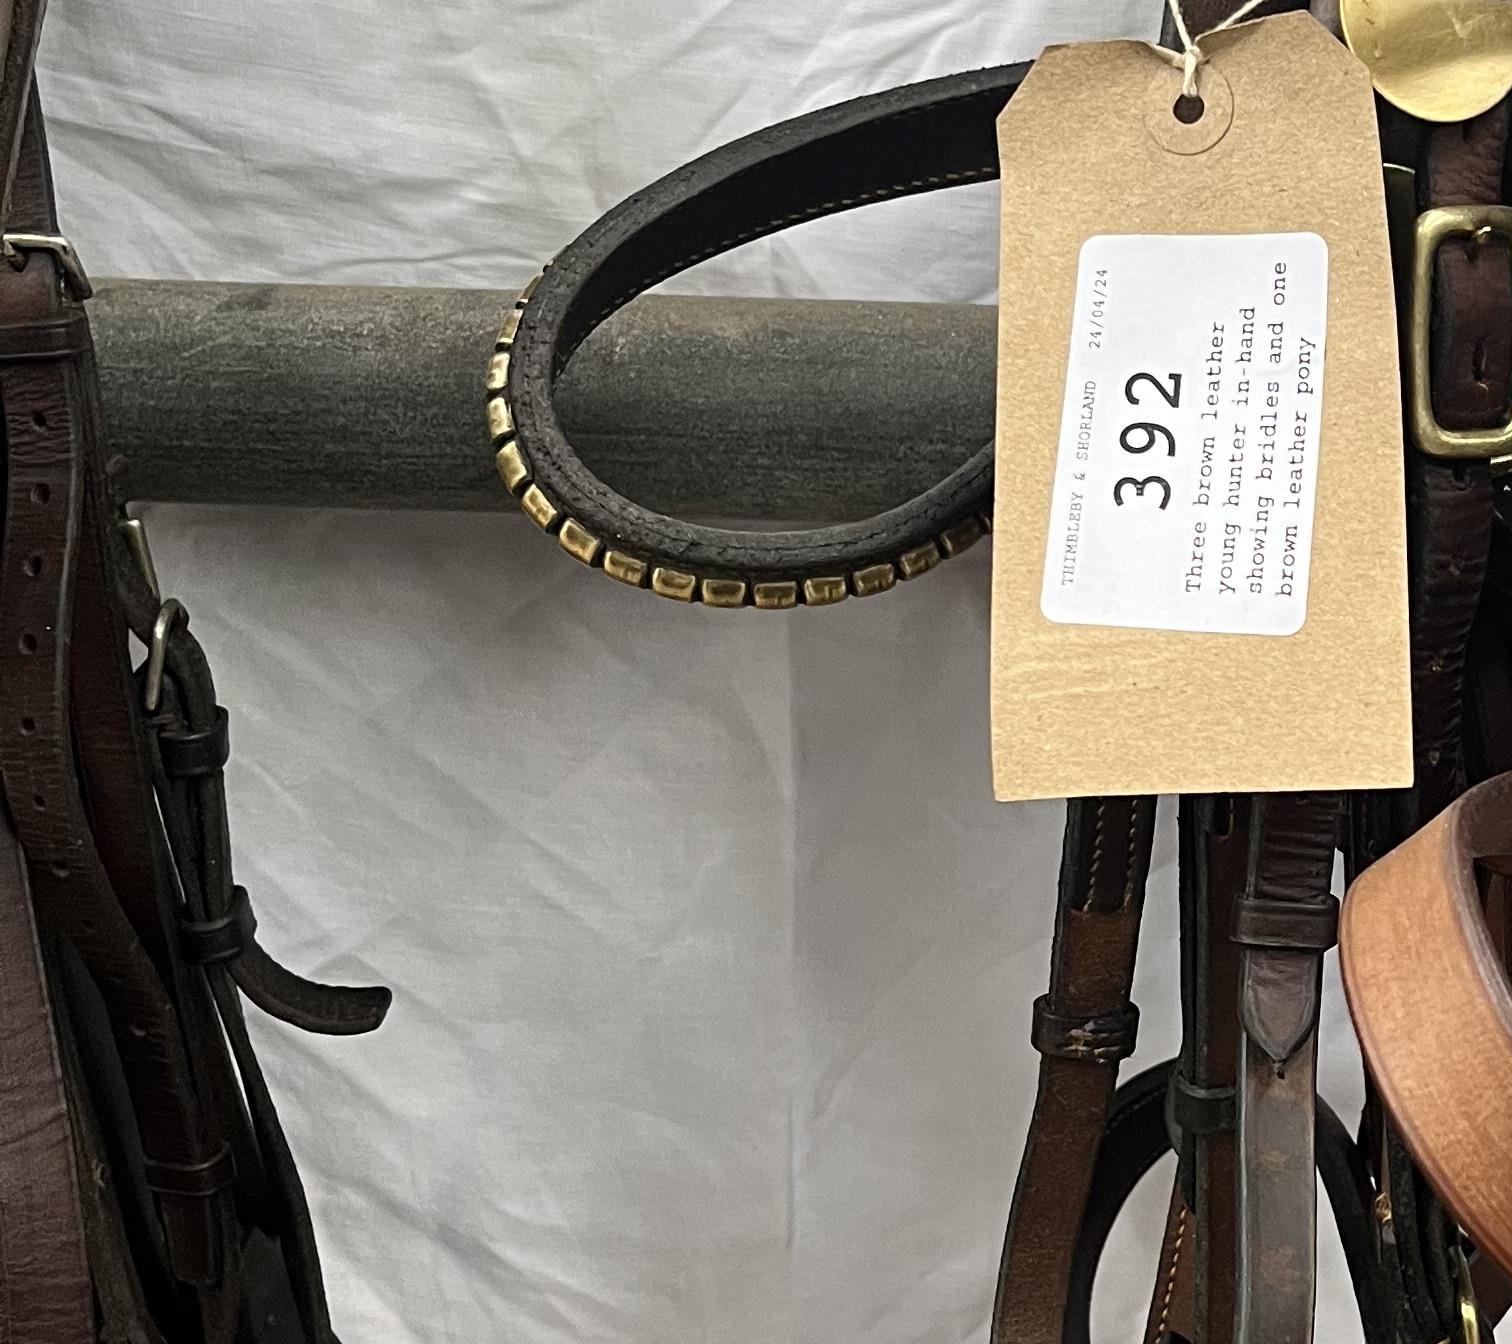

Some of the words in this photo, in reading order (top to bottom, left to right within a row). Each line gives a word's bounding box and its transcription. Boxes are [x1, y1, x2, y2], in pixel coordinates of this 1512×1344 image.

[1089, 269, 1108, 349] 24/04/24
[1274, 262, 1287, 306] one
[1201, 322, 1225, 421] leather
[1233, 307, 1256, 407] in-hand
[1267, 322, 1284, 364] and
[1297, 337, 1317, 395] pony
[1076, 381, 1096, 461] SHORLAND
[1113, 372, 1183, 511] 392
[1255, 380, 1280, 481] bridles
[1283, 411, 1308, 509] leather
[1073, 472, 1086, 482] &
[1192, 437, 1216, 506] brown
[1222, 424, 1247, 507] hunter
[1062, 491, 1084, 586] THIMBLEBY
[1185, 522, 1207, 593] Three
[1219, 522, 1242, 595] young
[1249, 496, 1275, 594] showing
[1275, 525, 1299, 598] brown
